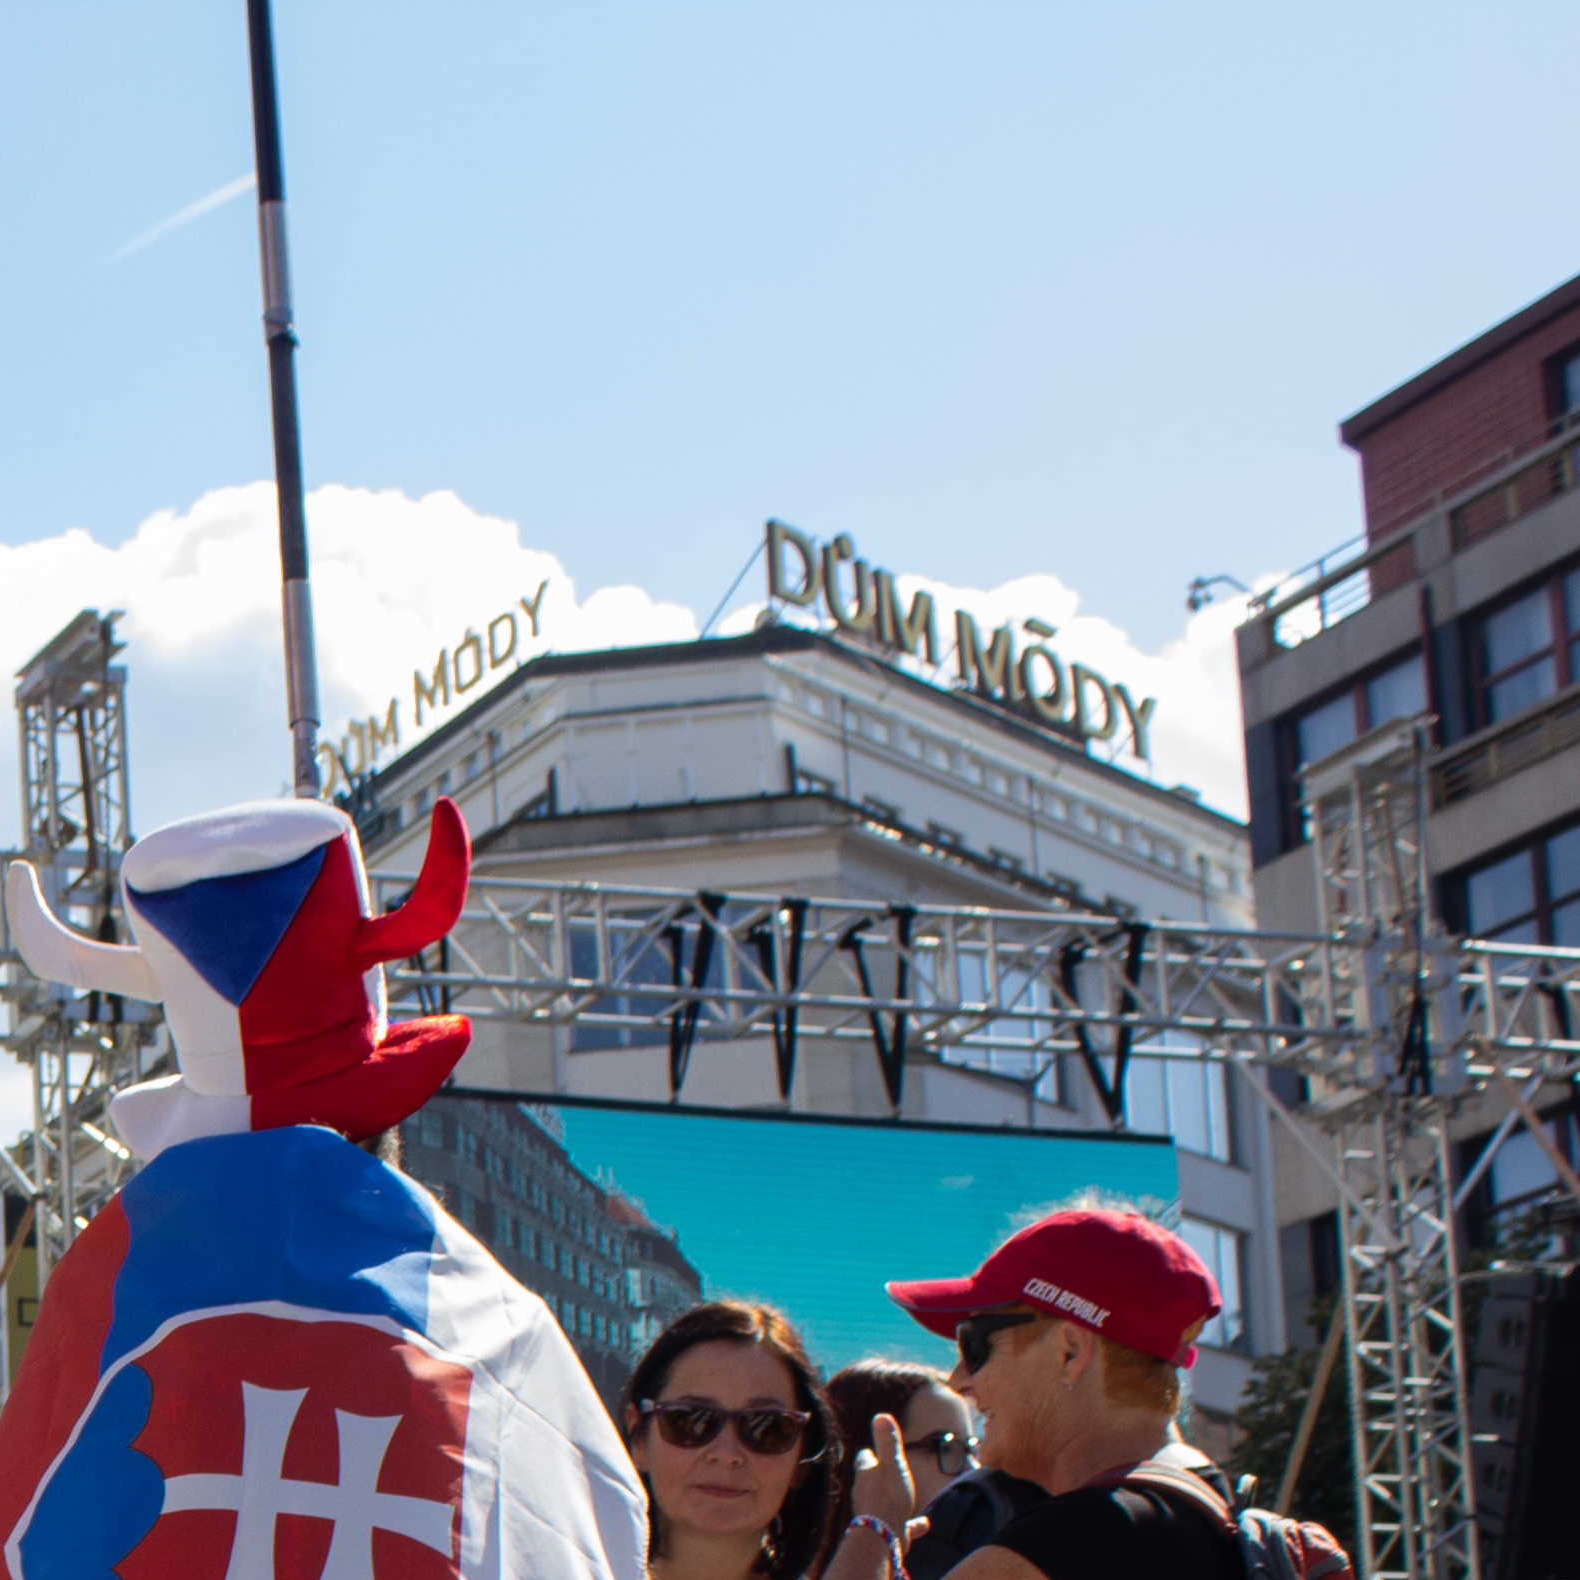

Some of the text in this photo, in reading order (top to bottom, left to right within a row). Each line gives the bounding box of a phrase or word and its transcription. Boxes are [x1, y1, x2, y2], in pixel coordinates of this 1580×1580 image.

[765, 517, 941, 668] DŮM
[1022, 1277, 1112, 1329] CZECH REPUBLIC
